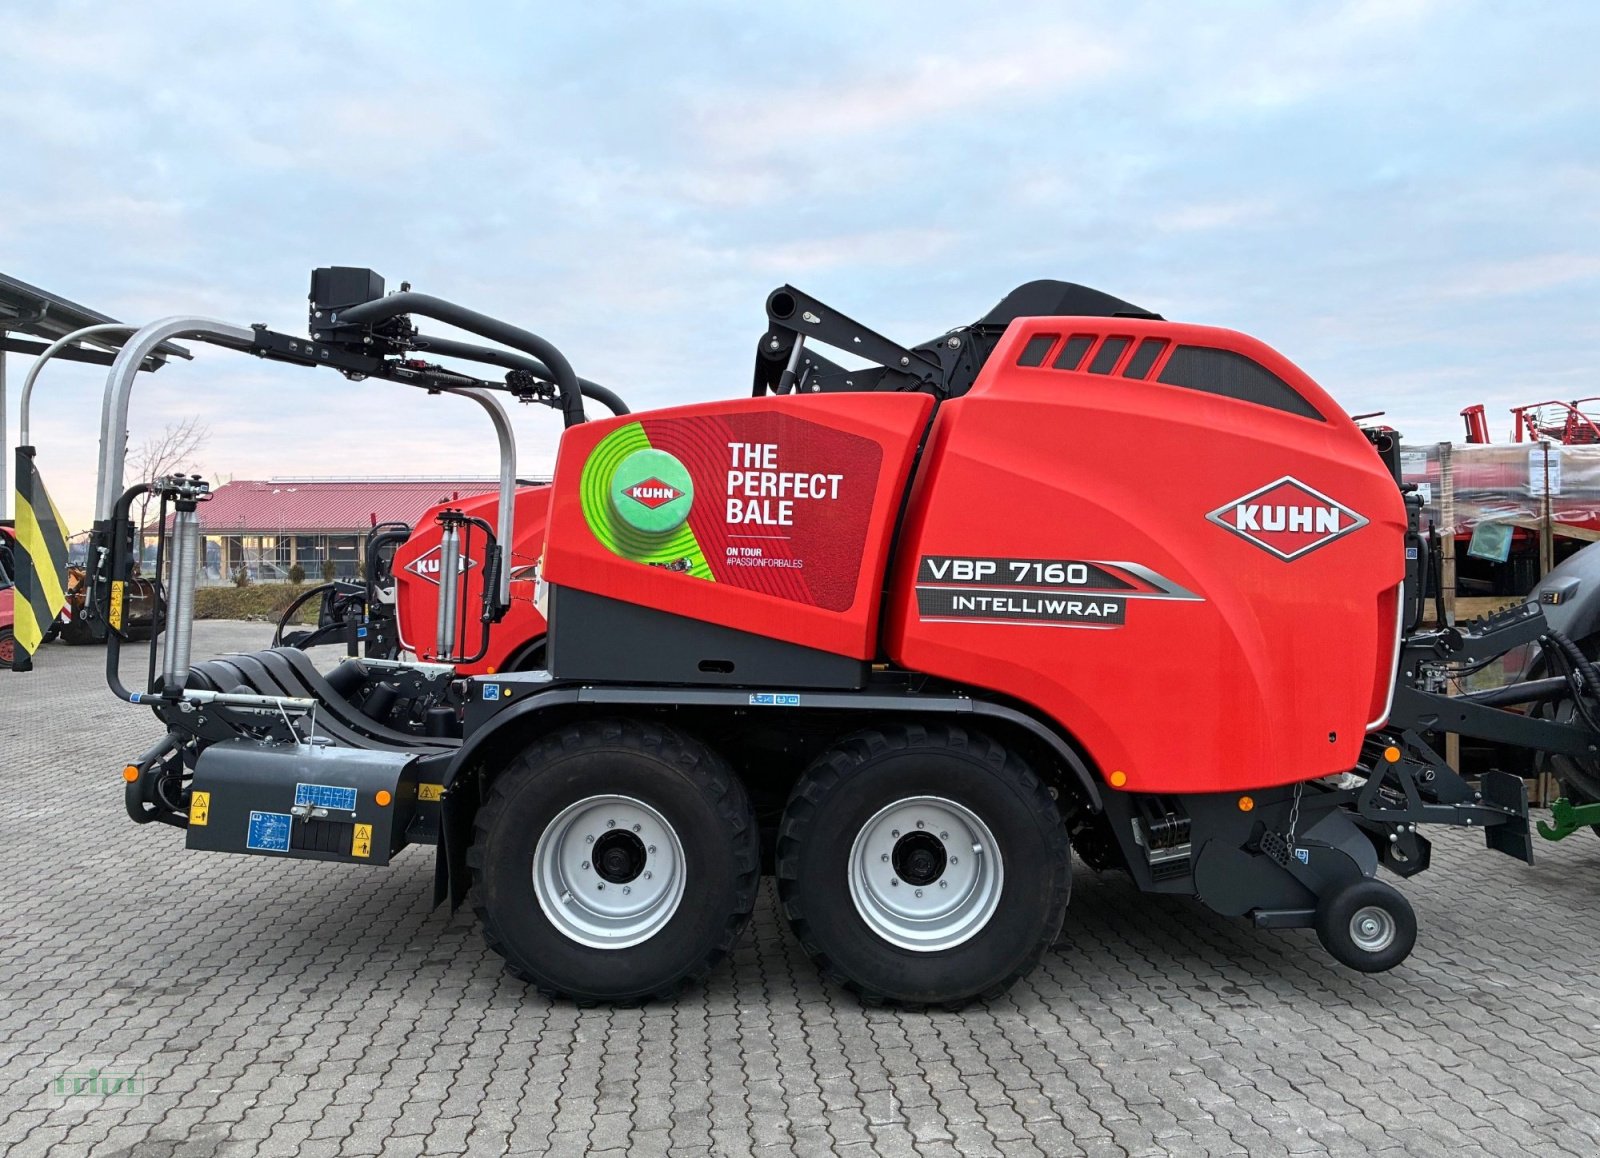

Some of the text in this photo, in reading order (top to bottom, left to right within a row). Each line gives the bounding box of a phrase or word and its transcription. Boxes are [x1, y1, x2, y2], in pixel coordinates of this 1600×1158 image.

[727, 442, 778, 469] THE
[632, 486, 674, 499] KUHN
[727, 471, 843, 500] PERFECT
[726, 499, 794, 526] BALE
[1235, 504, 1340, 534] KUHN
[726, 547, 762, 557] ON TOUR
[726, 557, 803, 569] #PASSIONFORBALES
[416, 558, 465, 573] KU
[926, 559, 1088, 585] VBP 7160
[952, 596, 1118, 618] INTELLIWRAP
